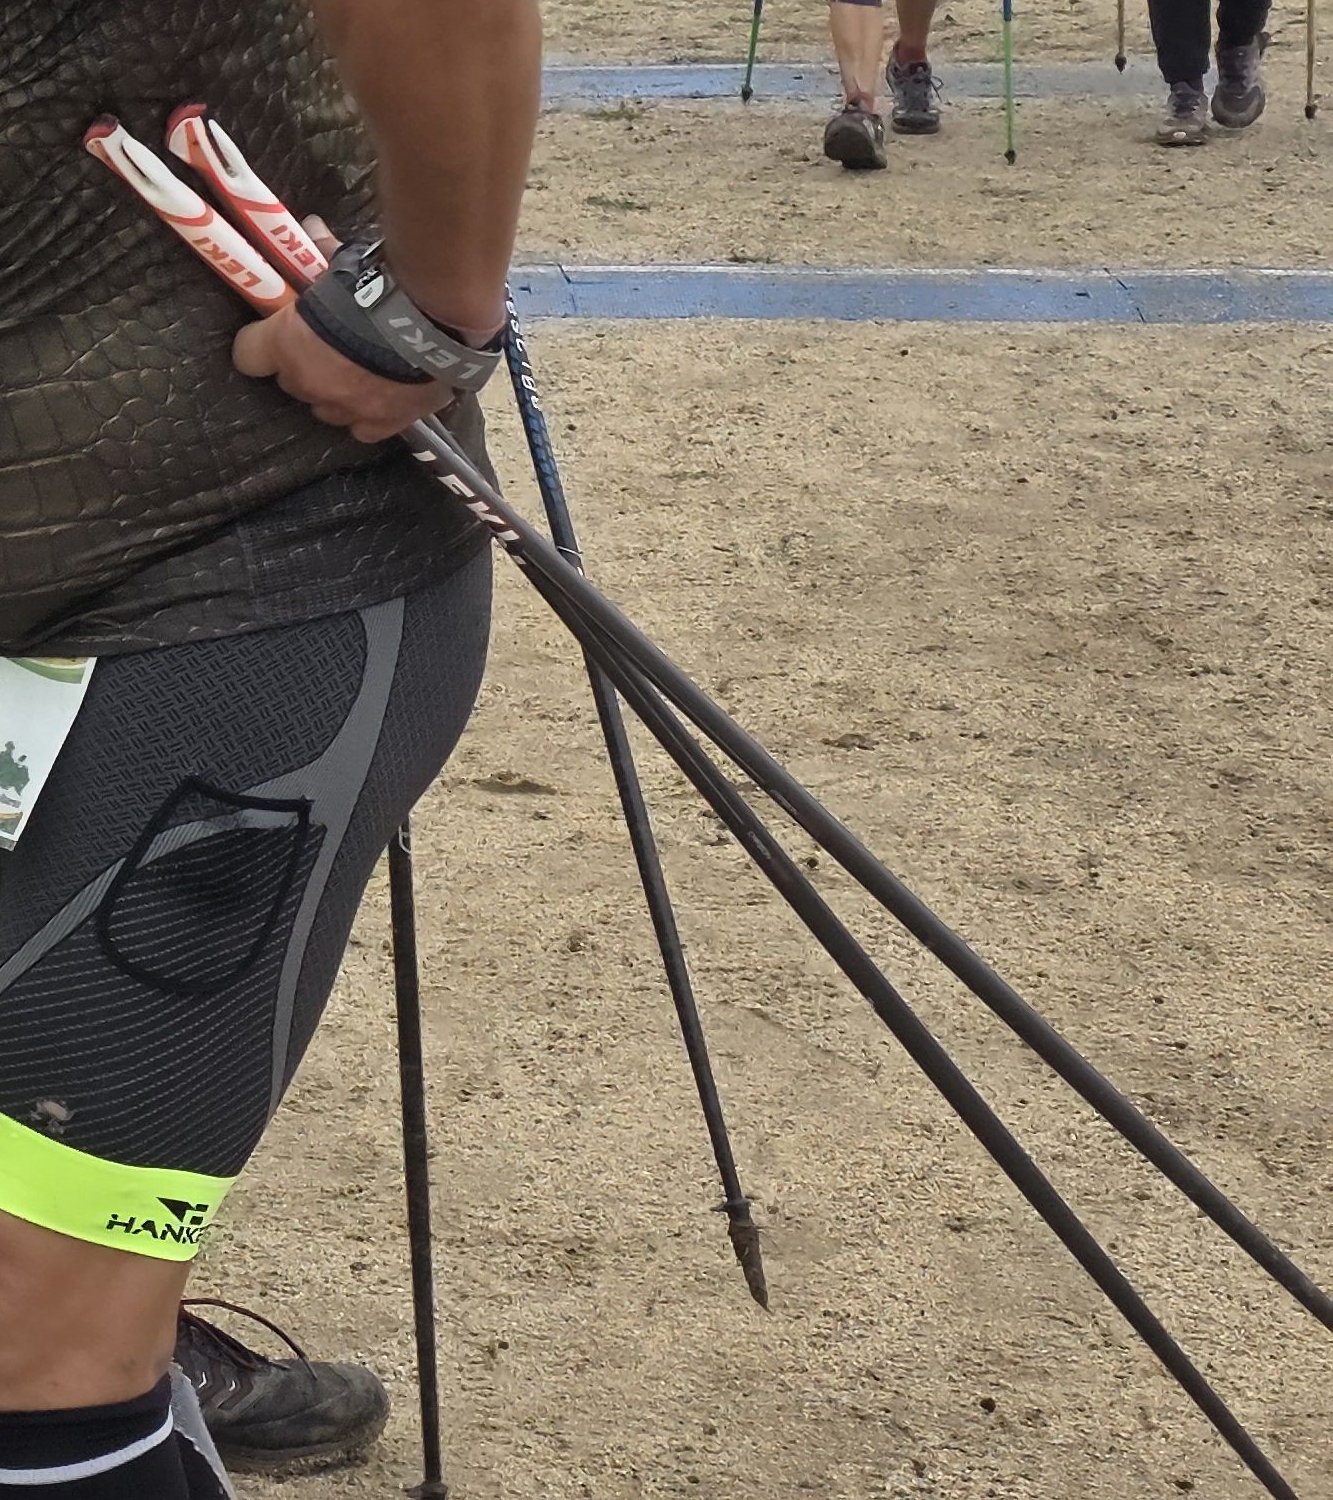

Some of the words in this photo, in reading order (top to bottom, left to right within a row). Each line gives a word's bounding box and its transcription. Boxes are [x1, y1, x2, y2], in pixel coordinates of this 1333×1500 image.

[191, 236, 263, 288] LEKI
[270, 224, 327, 281] LEKI
[388, 317, 484, 380] LEKI
